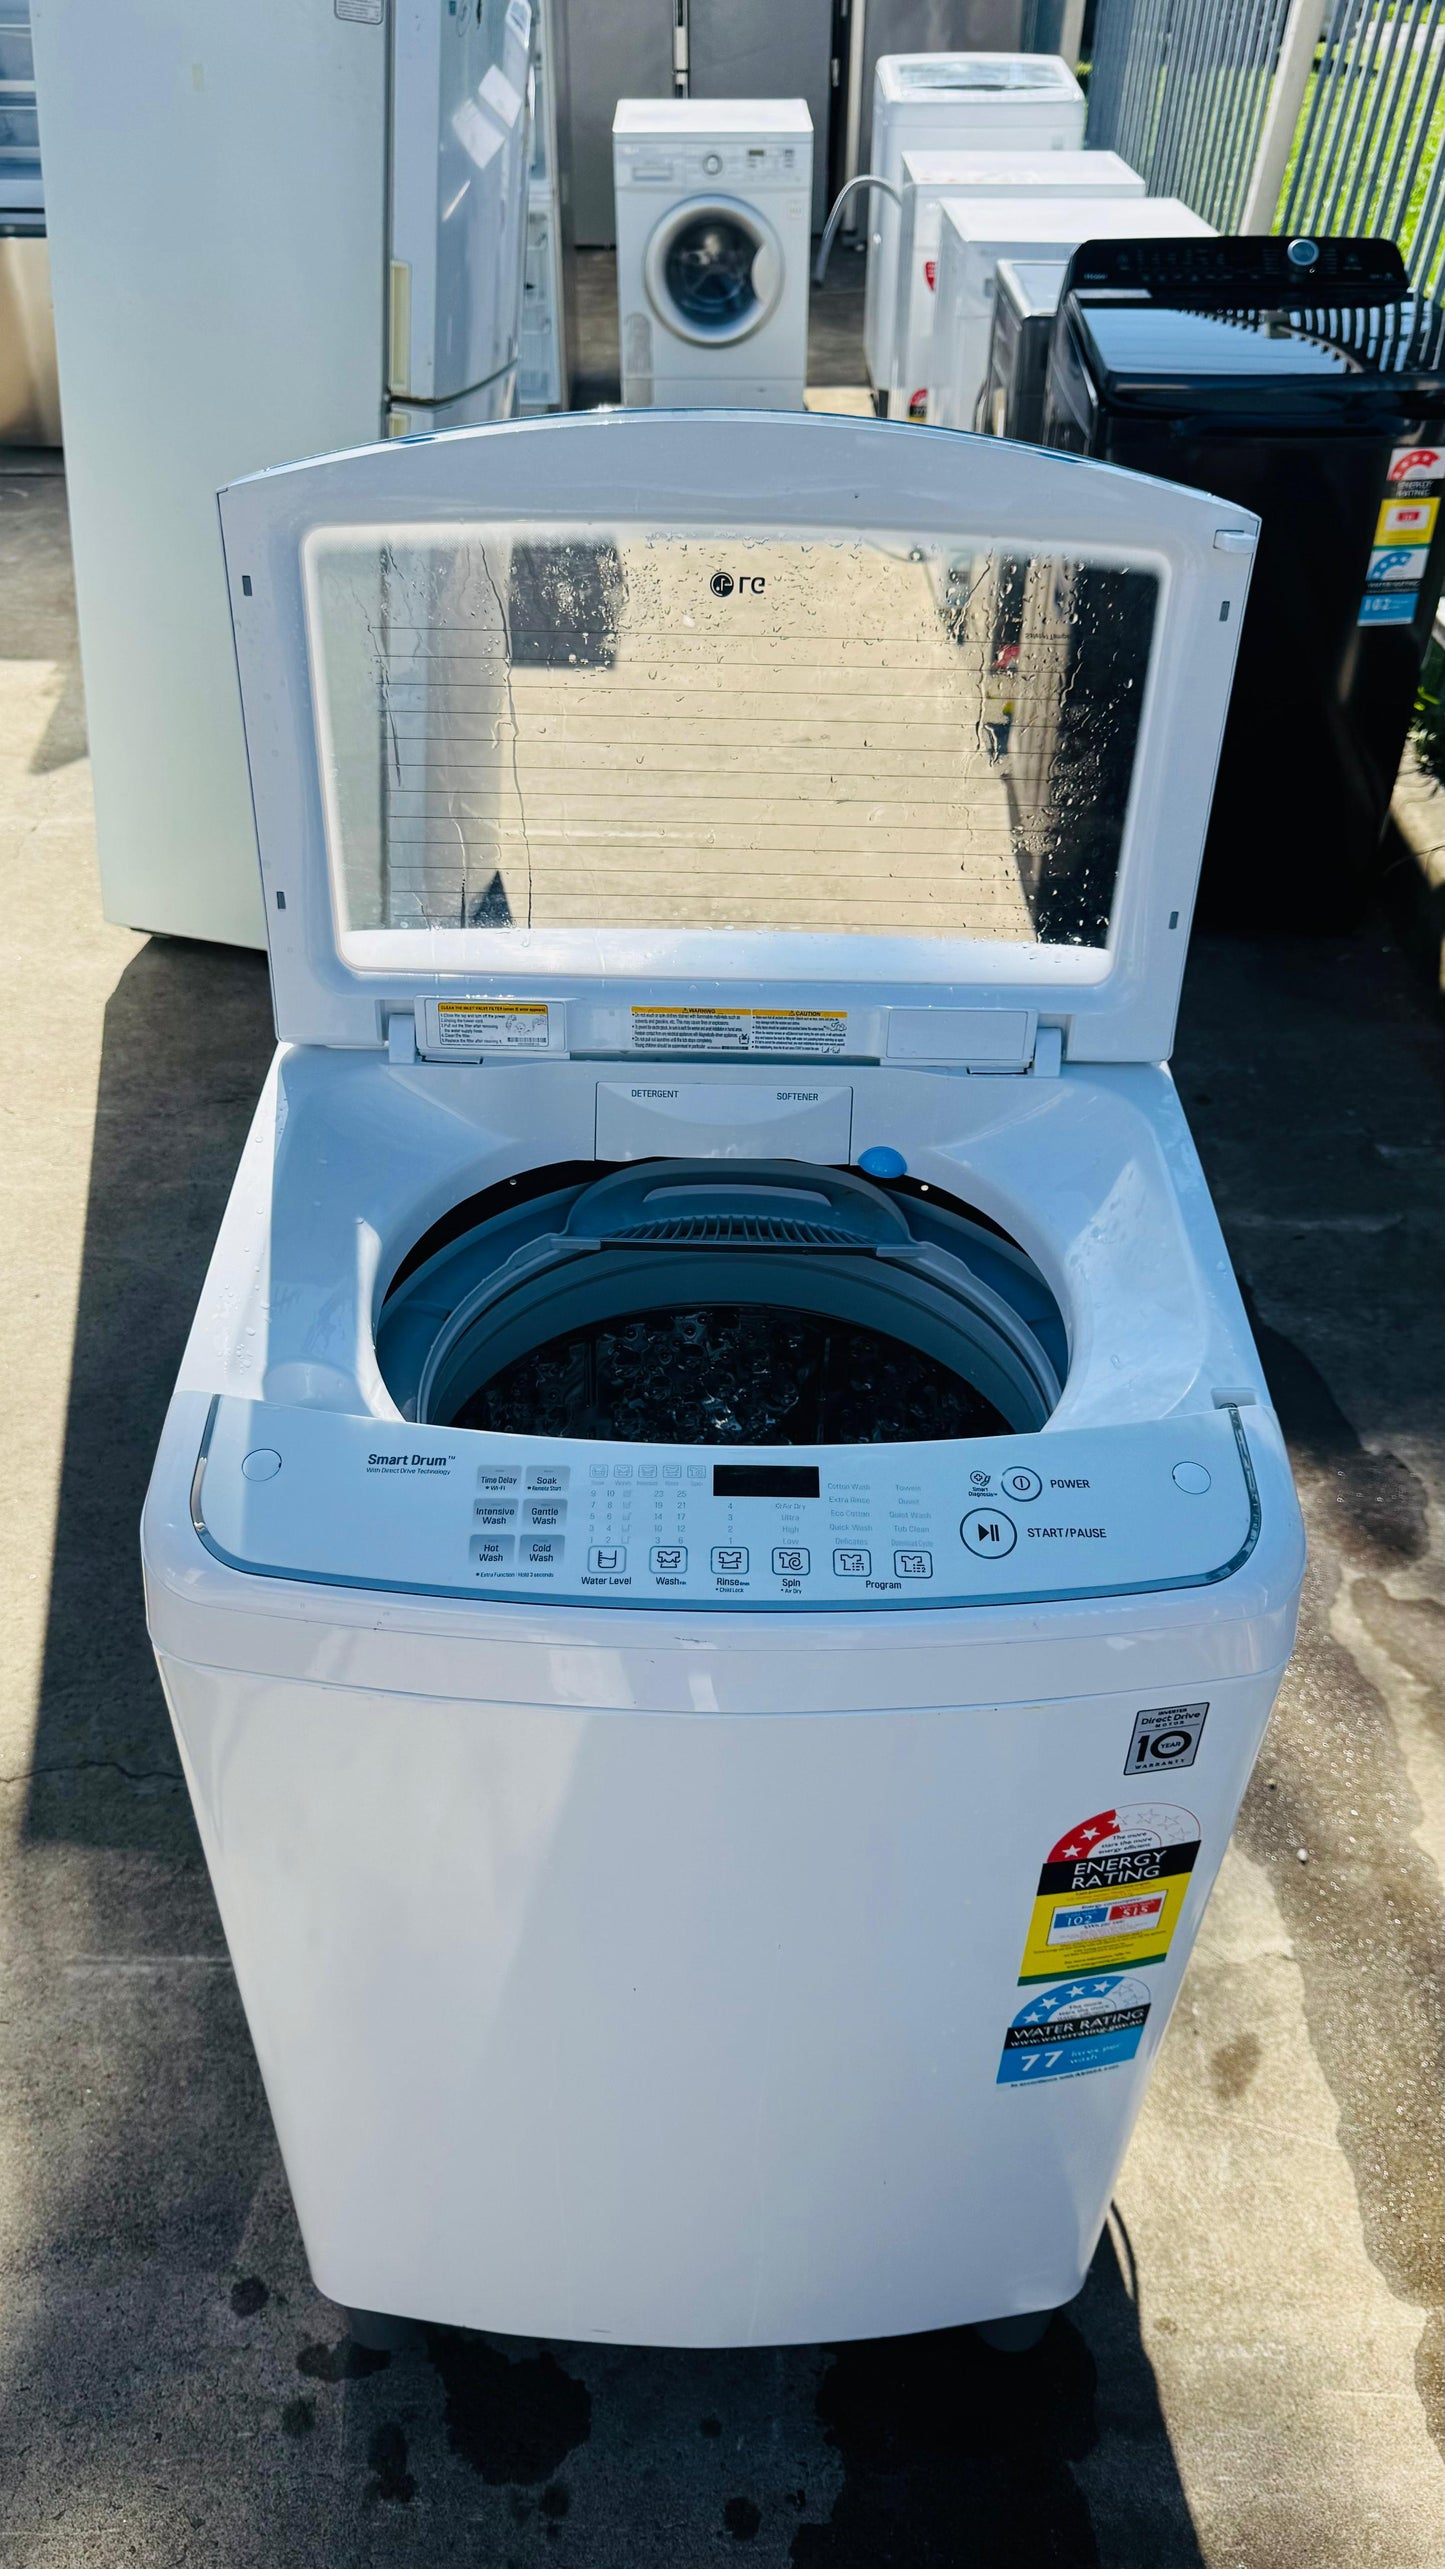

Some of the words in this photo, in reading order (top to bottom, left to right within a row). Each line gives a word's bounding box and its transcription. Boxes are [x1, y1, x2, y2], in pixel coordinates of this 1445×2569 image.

[631, 1089, 679, 1098] DETERGENT
[777, 1092, 818, 1101] SOFTENER
[368, 1453, 409, 1466] Smart
[481, 1476, 497, 1484] Time
[498, 1476, 517, 1485] Delay
[536, 1476, 557, 1485] Soak
[1050, 1479, 1091, 1489] POWER
[607, 1490, 615, 1498] 10
[591, 1501, 596, 1509] 7
[677, 1501, 686, 1509] 21
[727, 1502, 733, 1510] 4
[476, 1507, 515, 1516] Intensive
[531, 1507, 559, 1516] Gentle
[482, 1516, 507, 1525] Wash
[532, 1516, 557, 1525] Wash
[677, 1524, 686, 1532] 12
[727, 1525, 733, 1533] 2
[1027, 1528, 1108, 1538] START/PAUSE
[484, 1544, 499, 1552] Hot
[532, 1544, 552, 1552] Cold
[479, 1554, 504, 1562] Wash
[529, 1554, 554, 1562] Wash
[581, 1577, 606, 1585] Water
[609, 1577, 632, 1585] Level
[656, 1577, 679, 1585] Wash
[717, 1578, 739, 1586] Rinse
[782, 1578, 801, 1587] Spin
[865, 1580, 902, 1590] Program
[1141, 1716, 1171, 1725] Direct
[1173, 1712, 1201, 1721] Drive
[1136, 1730, 1192, 1763] 10
[1160, 1741, 1182, 1749] YEAR
[1135, 1758, 1185, 1770] WARRANTY
[1074, 1850, 1167, 1876] ENERGY
[1071, 1865, 1160, 1890] RATING
[1067, 1915, 1092, 1927] 102
[1014, 2023, 1073, 2039] WATER
[1080, 2009, 1144, 2029] RATING
[1021, 2050, 1063, 2072] 77
